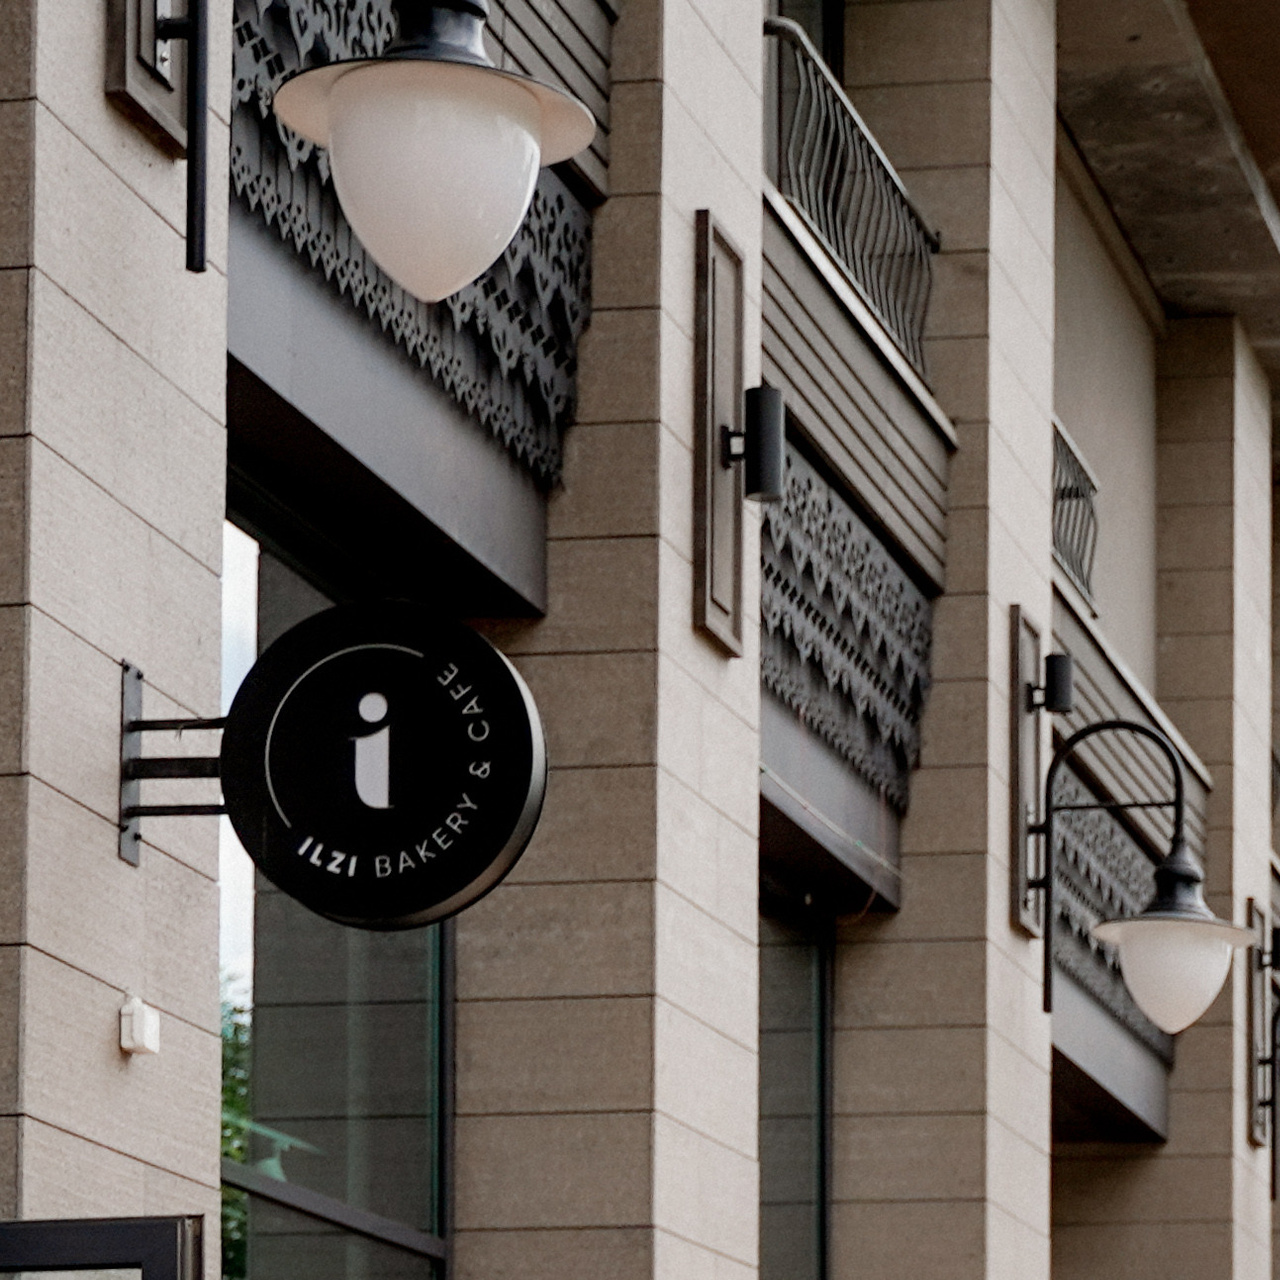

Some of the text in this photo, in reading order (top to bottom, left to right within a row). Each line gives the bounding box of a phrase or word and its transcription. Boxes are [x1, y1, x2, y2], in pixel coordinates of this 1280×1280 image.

[298, 662, 491, 878] ILZI BAKERY & CAFE
[349, 692, 393, 809] i
